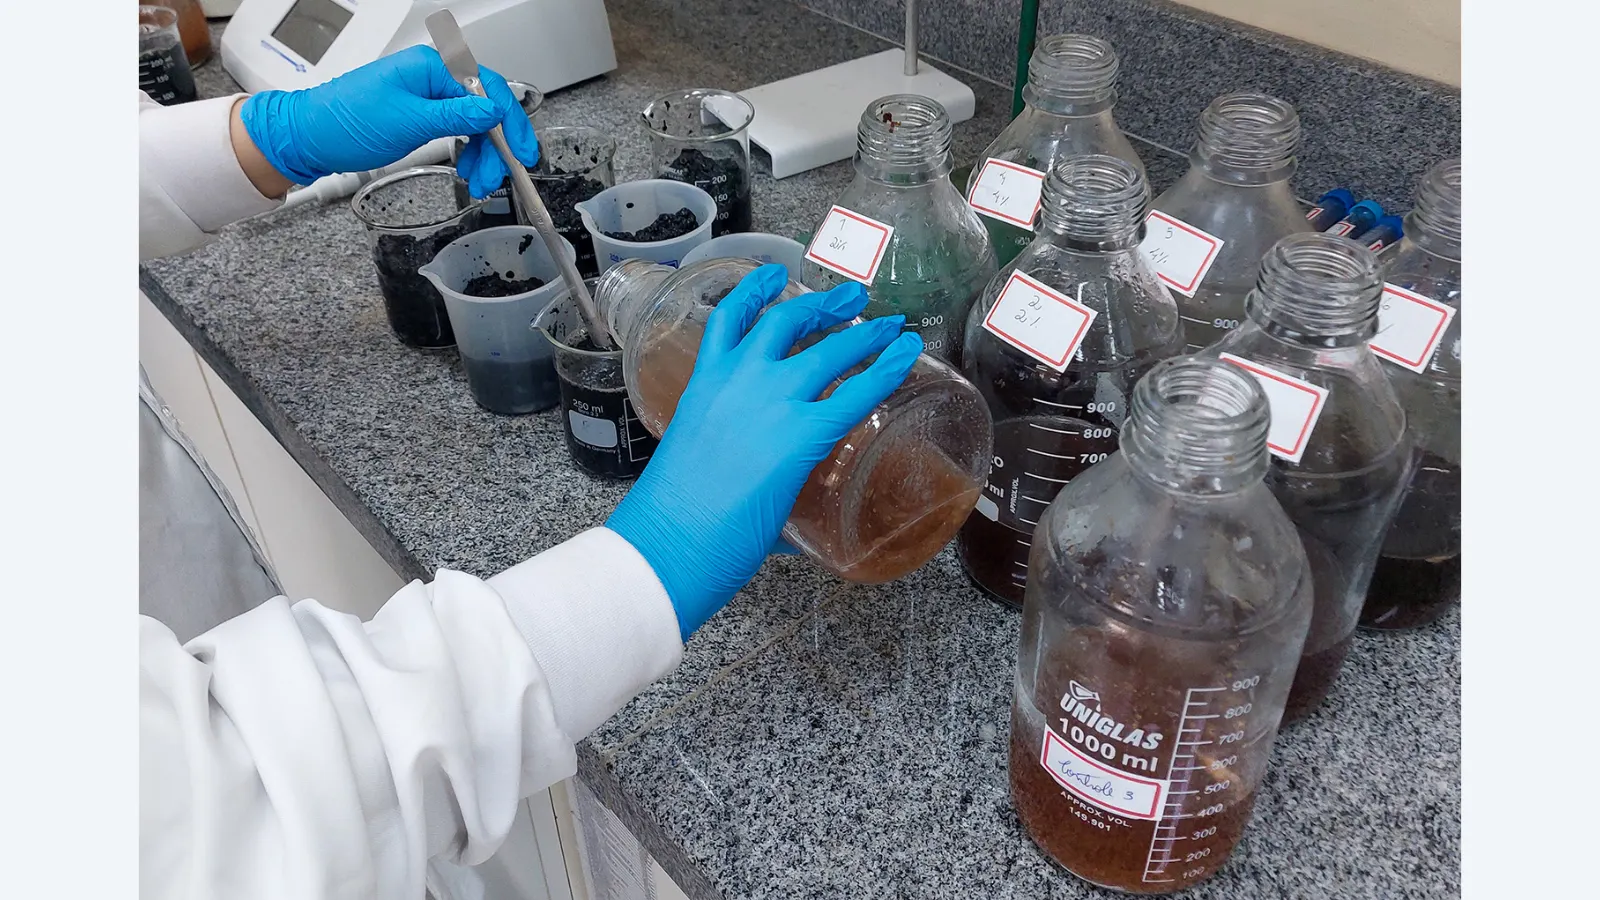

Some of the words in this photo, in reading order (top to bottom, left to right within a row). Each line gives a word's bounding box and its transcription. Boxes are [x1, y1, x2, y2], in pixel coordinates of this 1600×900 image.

[712, 175, 727, 185] 200
[714, 194, 728, 203] 150
[716, 212, 729, 221] 100
[1165, 227, 1173, 239] 5
[1028, 295, 1042, 310] 2
[921, 315, 943, 327] 900
[1213, 318, 1239, 329] 900
[573, 399, 589, 411] 250
[592, 405, 604, 413] ml
[1086, 401, 1116, 413] 900
[1083, 427, 1112, 439] 800
[1080, 453, 1107, 464] 700
[989, 484, 1004, 498] ml
[1231, 675, 1260, 692] 900
[1224, 703, 1252, 719] 800
[1060, 717, 1116, 760] 1000
[1122, 753, 1159, 772] ml
[1219, 730, 1244, 746] 700
[1211, 755, 1238, 770] 600
[1203, 780, 1230, 795] 500
[1123, 790, 1134, 801] 3
[1060, 790, 1104, 819] APPROX.
[1107, 814, 1133, 828] VOL.
[1197, 803, 1224, 817] 400
[1069, 807, 1111, 832] 149.901
[1191, 826, 1217, 841] 300
[1185, 847, 1211, 862] 200
[1182, 866, 1205, 879] 100
